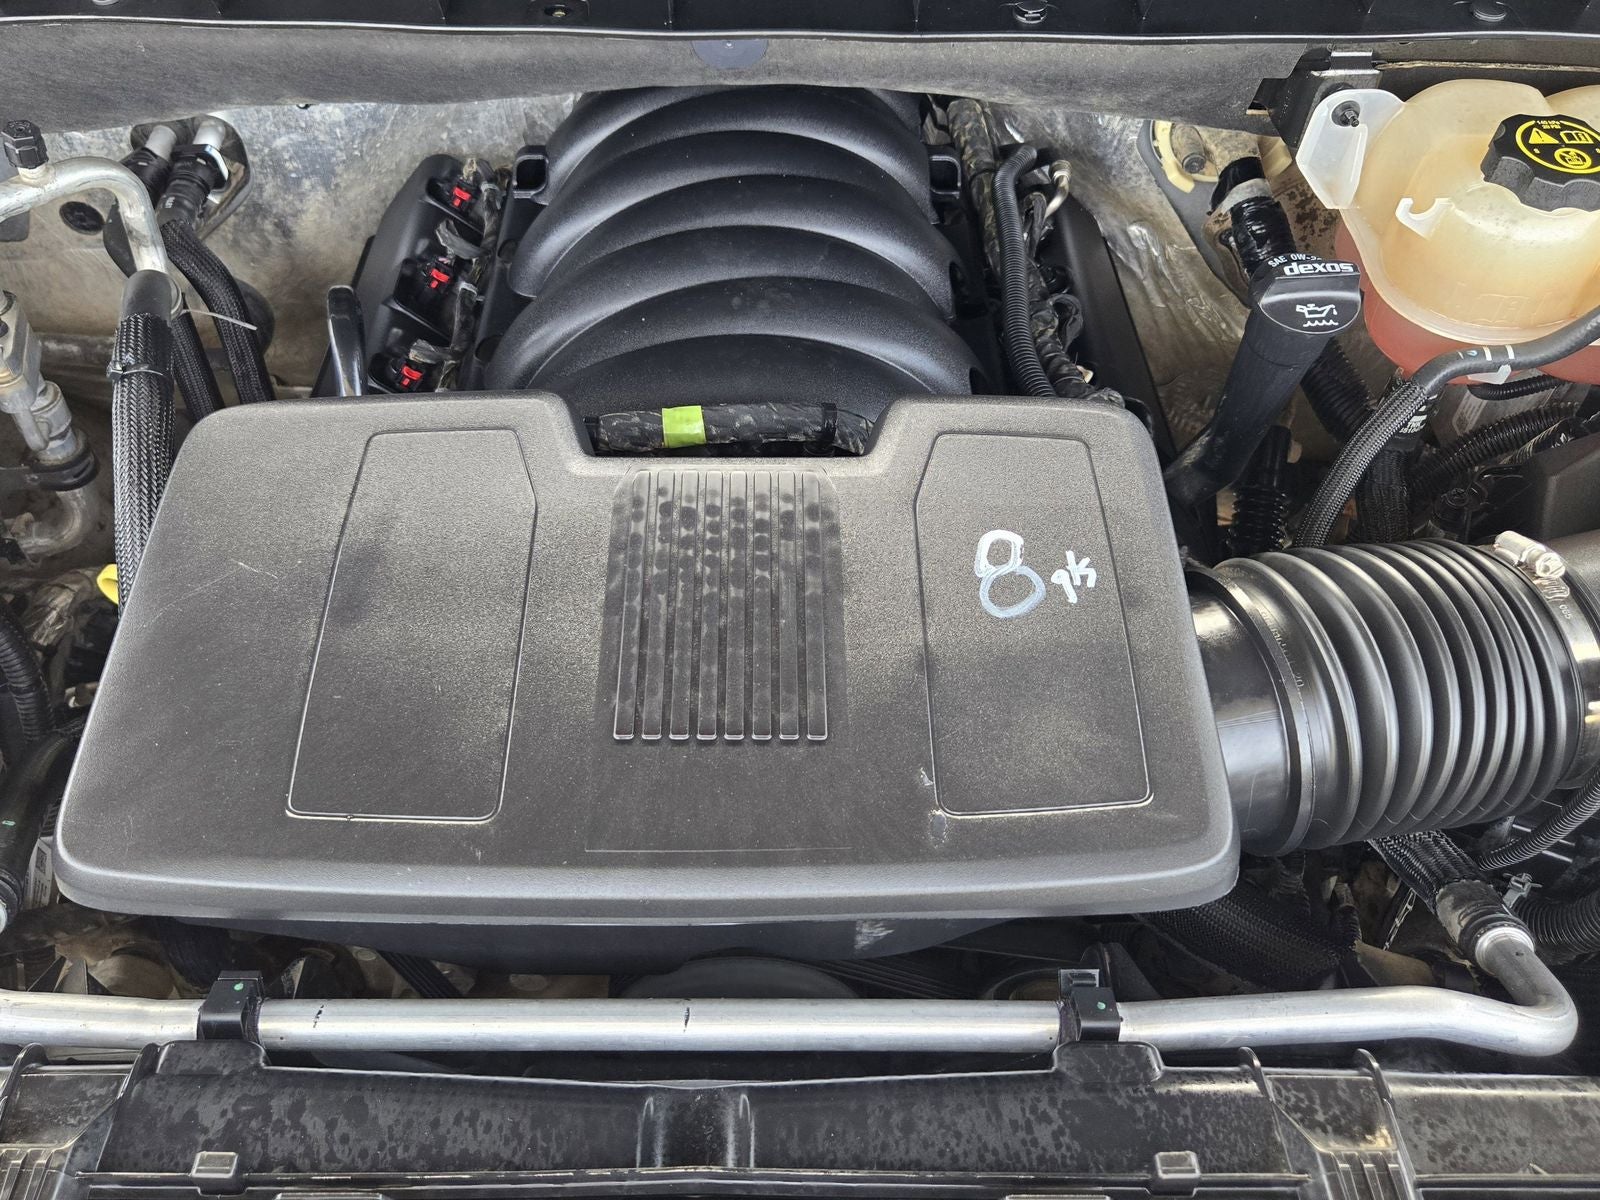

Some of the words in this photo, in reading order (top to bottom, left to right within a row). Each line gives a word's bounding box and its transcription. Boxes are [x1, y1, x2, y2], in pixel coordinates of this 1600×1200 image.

[1267, 255, 1288, 267] SAE
[1283, 262, 1354, 276] dexos
[974, 529, 1046, 618] 8
